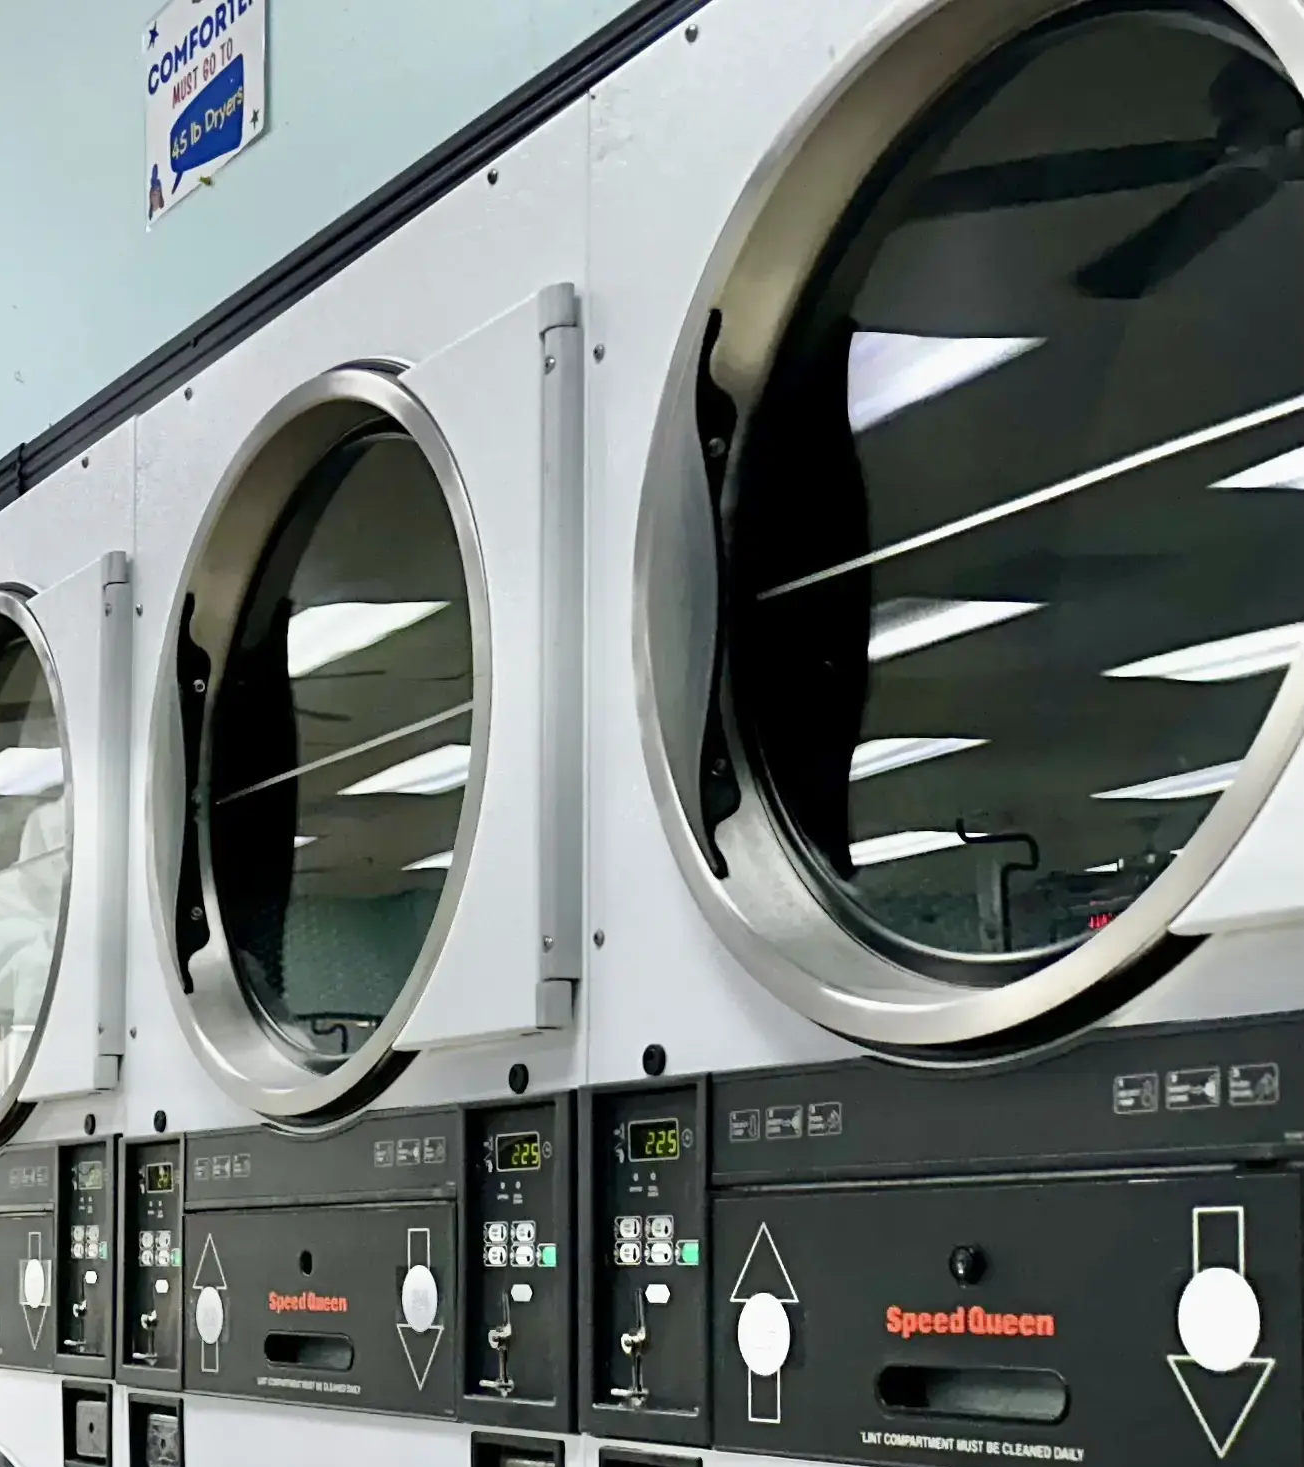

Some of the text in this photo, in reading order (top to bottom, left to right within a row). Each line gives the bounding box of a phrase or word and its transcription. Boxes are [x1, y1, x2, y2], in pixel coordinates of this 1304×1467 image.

[148, 0, 253, 95] COMFORTE
[172, 37, 234, 109] MUST GO TO
[171, 133, 188, 161] 45
[205, 86, 244, 132] Dryers
[511, 1143, 540, 1166] 225
[645, 1129, 677, 1155] 225
[886, 1304, 1055, 1339] Speed Queen
[956, 1438, 984, 1454] MUST
[986, 1441, 1000, 1456] BE
[1001, 1443, 1052, 1460] CLEANED
[1053, 1446, 1085, 1463] DAILY
